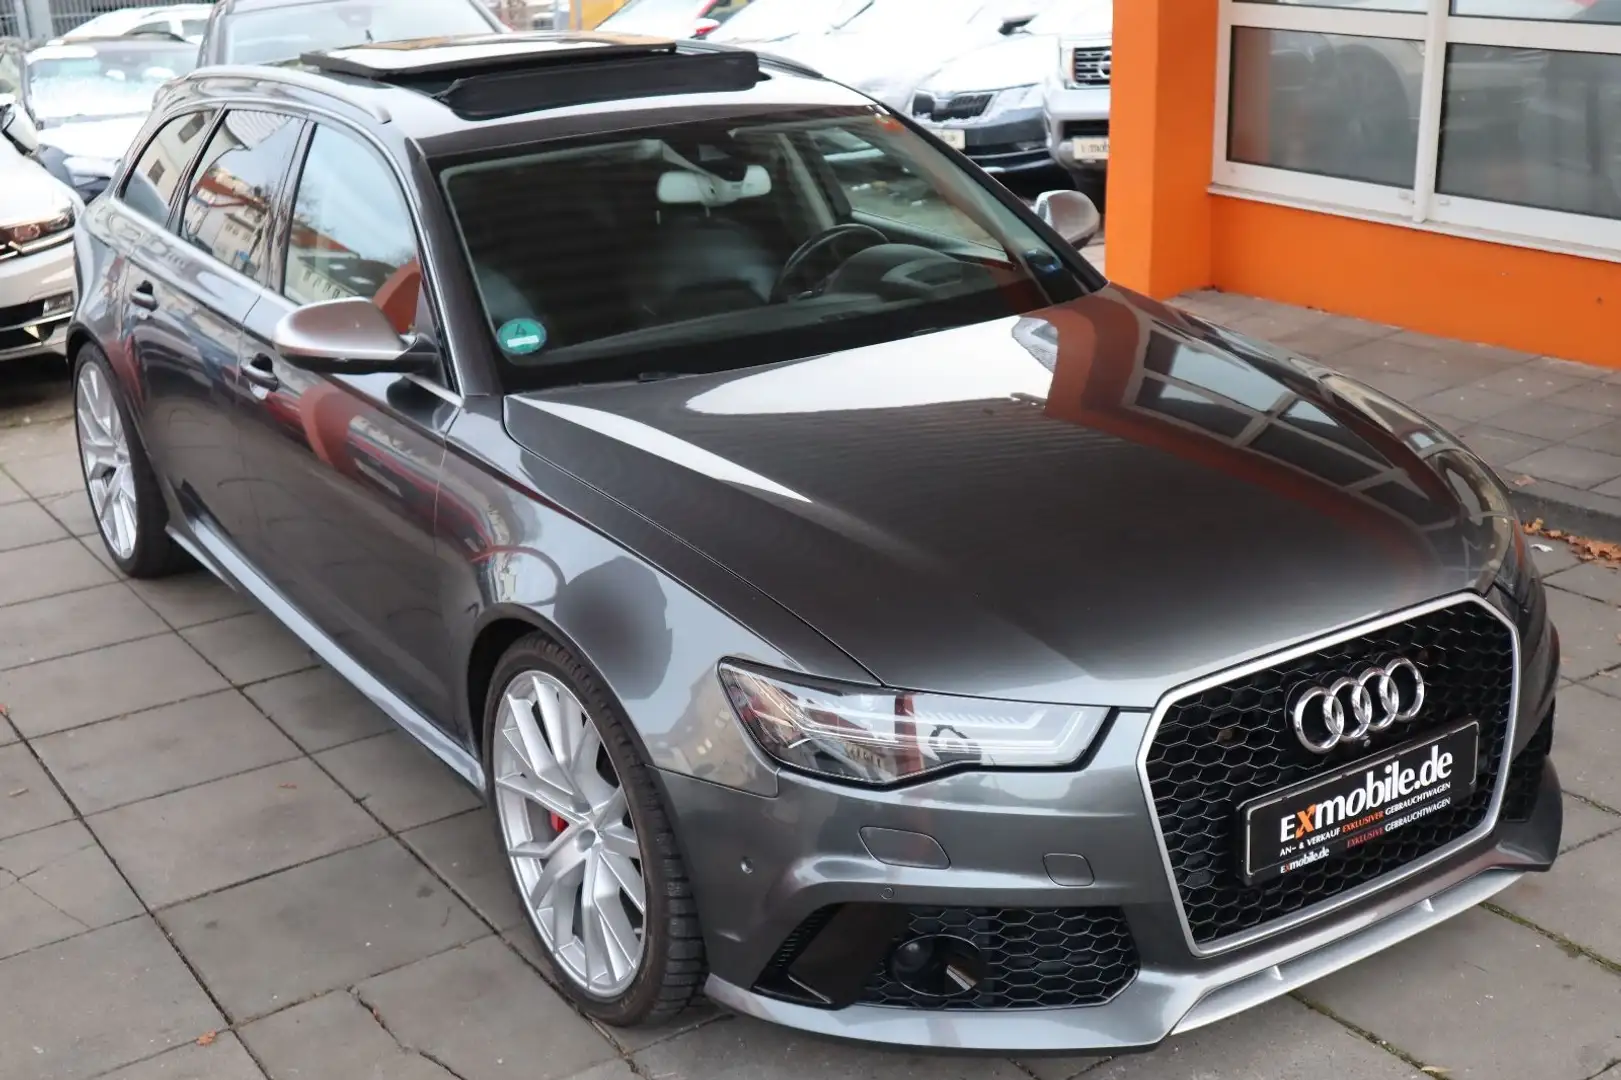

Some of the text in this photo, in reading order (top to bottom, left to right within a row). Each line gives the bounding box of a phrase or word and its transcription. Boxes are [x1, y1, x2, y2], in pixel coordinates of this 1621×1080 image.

[1280, 846, 1297, 857] AN-
[1306, 827, 1340, 846] VERKAUF
[1342, 811, 1384, 833] EXKLUSIVER
[1385, 782, 1451, 815] GEBRAUCHTWAGEN
[1347, 797, 1451, 849] EXKLUSIVE GEBRAUCHTWAGEN
